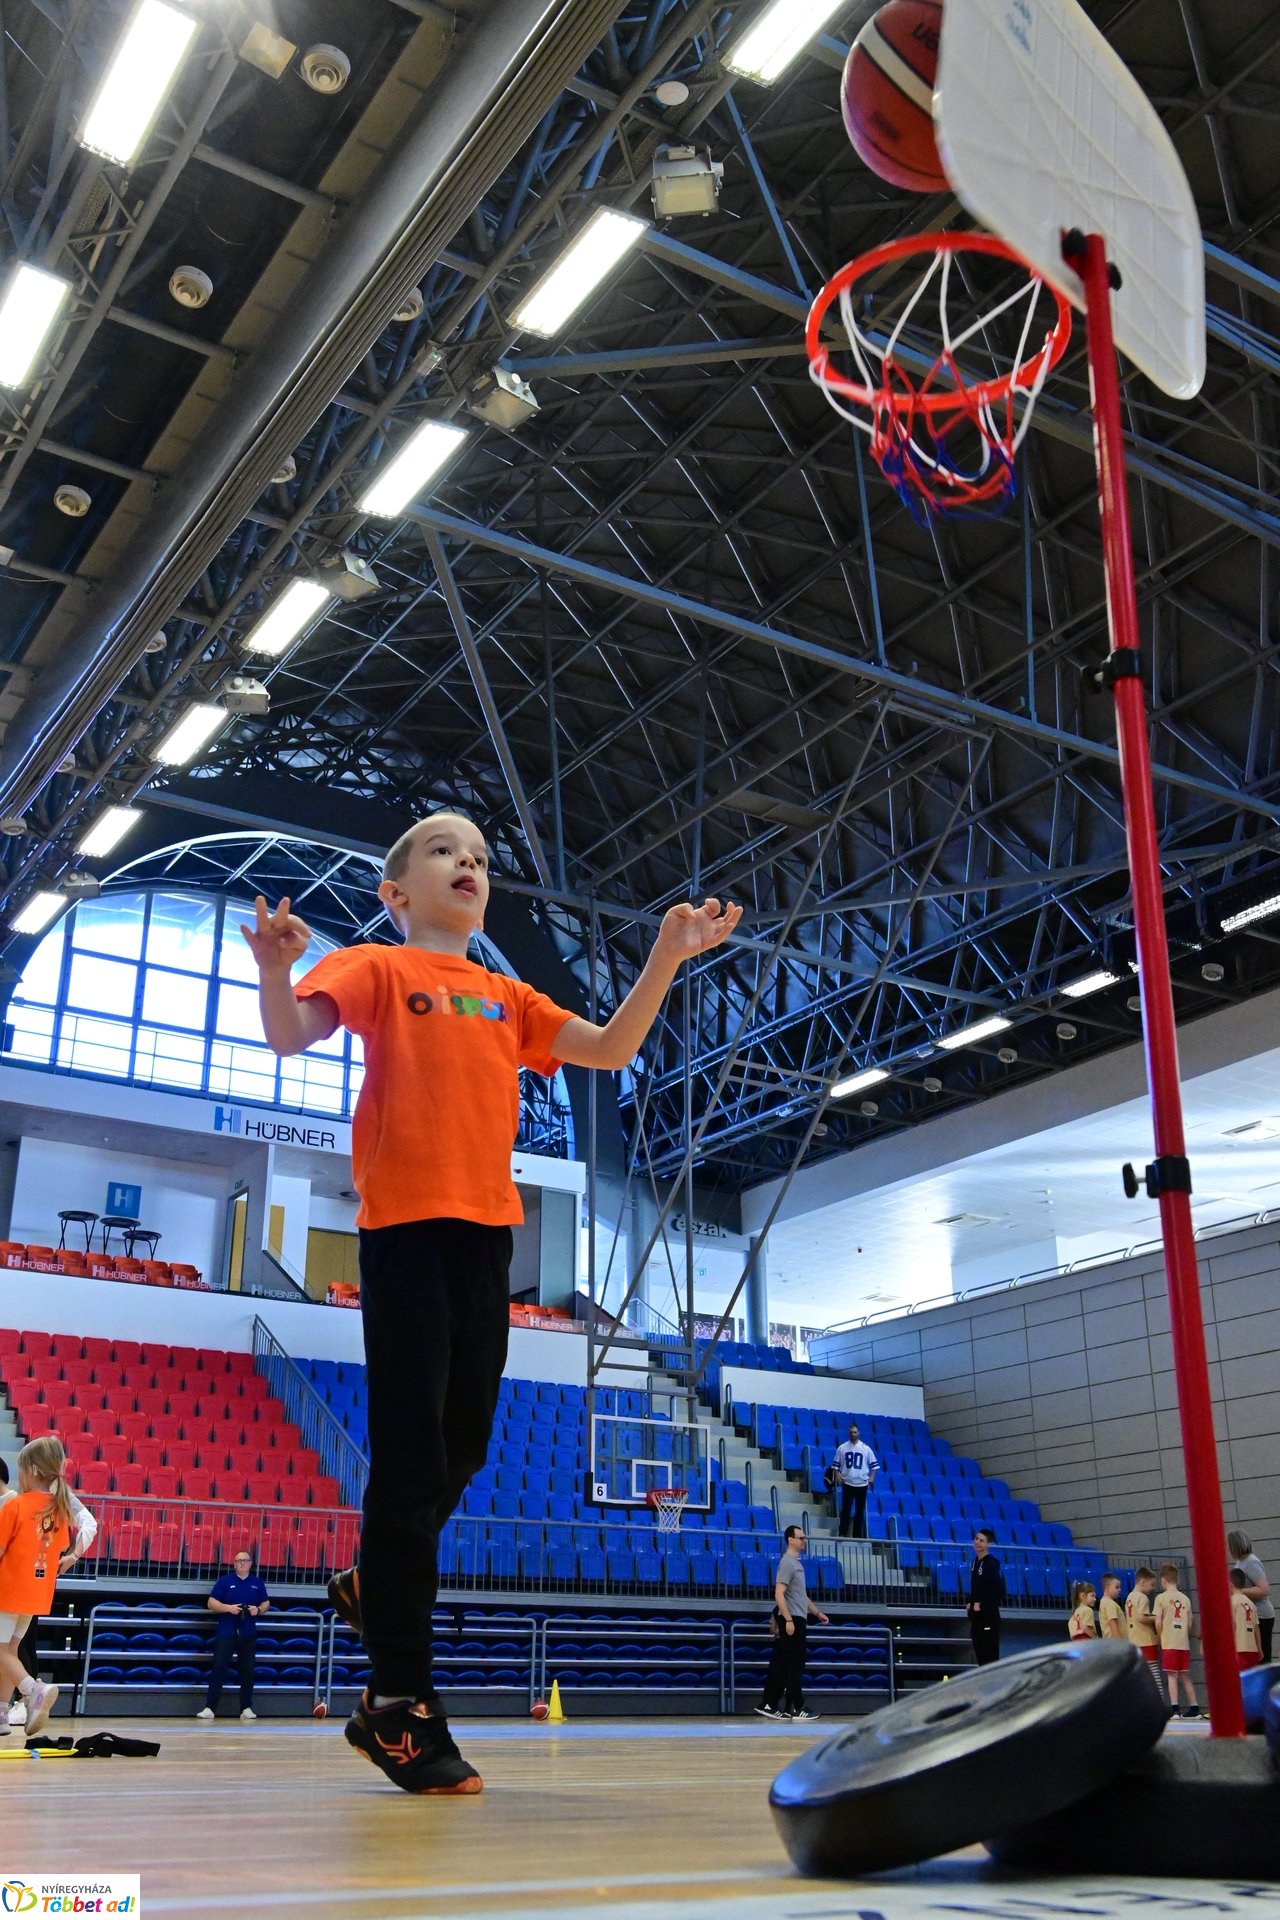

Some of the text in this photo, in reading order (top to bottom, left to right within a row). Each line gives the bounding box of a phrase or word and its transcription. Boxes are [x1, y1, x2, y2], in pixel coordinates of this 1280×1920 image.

[245, 1119, 335, 1149] HÜBNER
[845, 1452, 863, 1469] 80
[597, 1486, 604, 1497] 6
